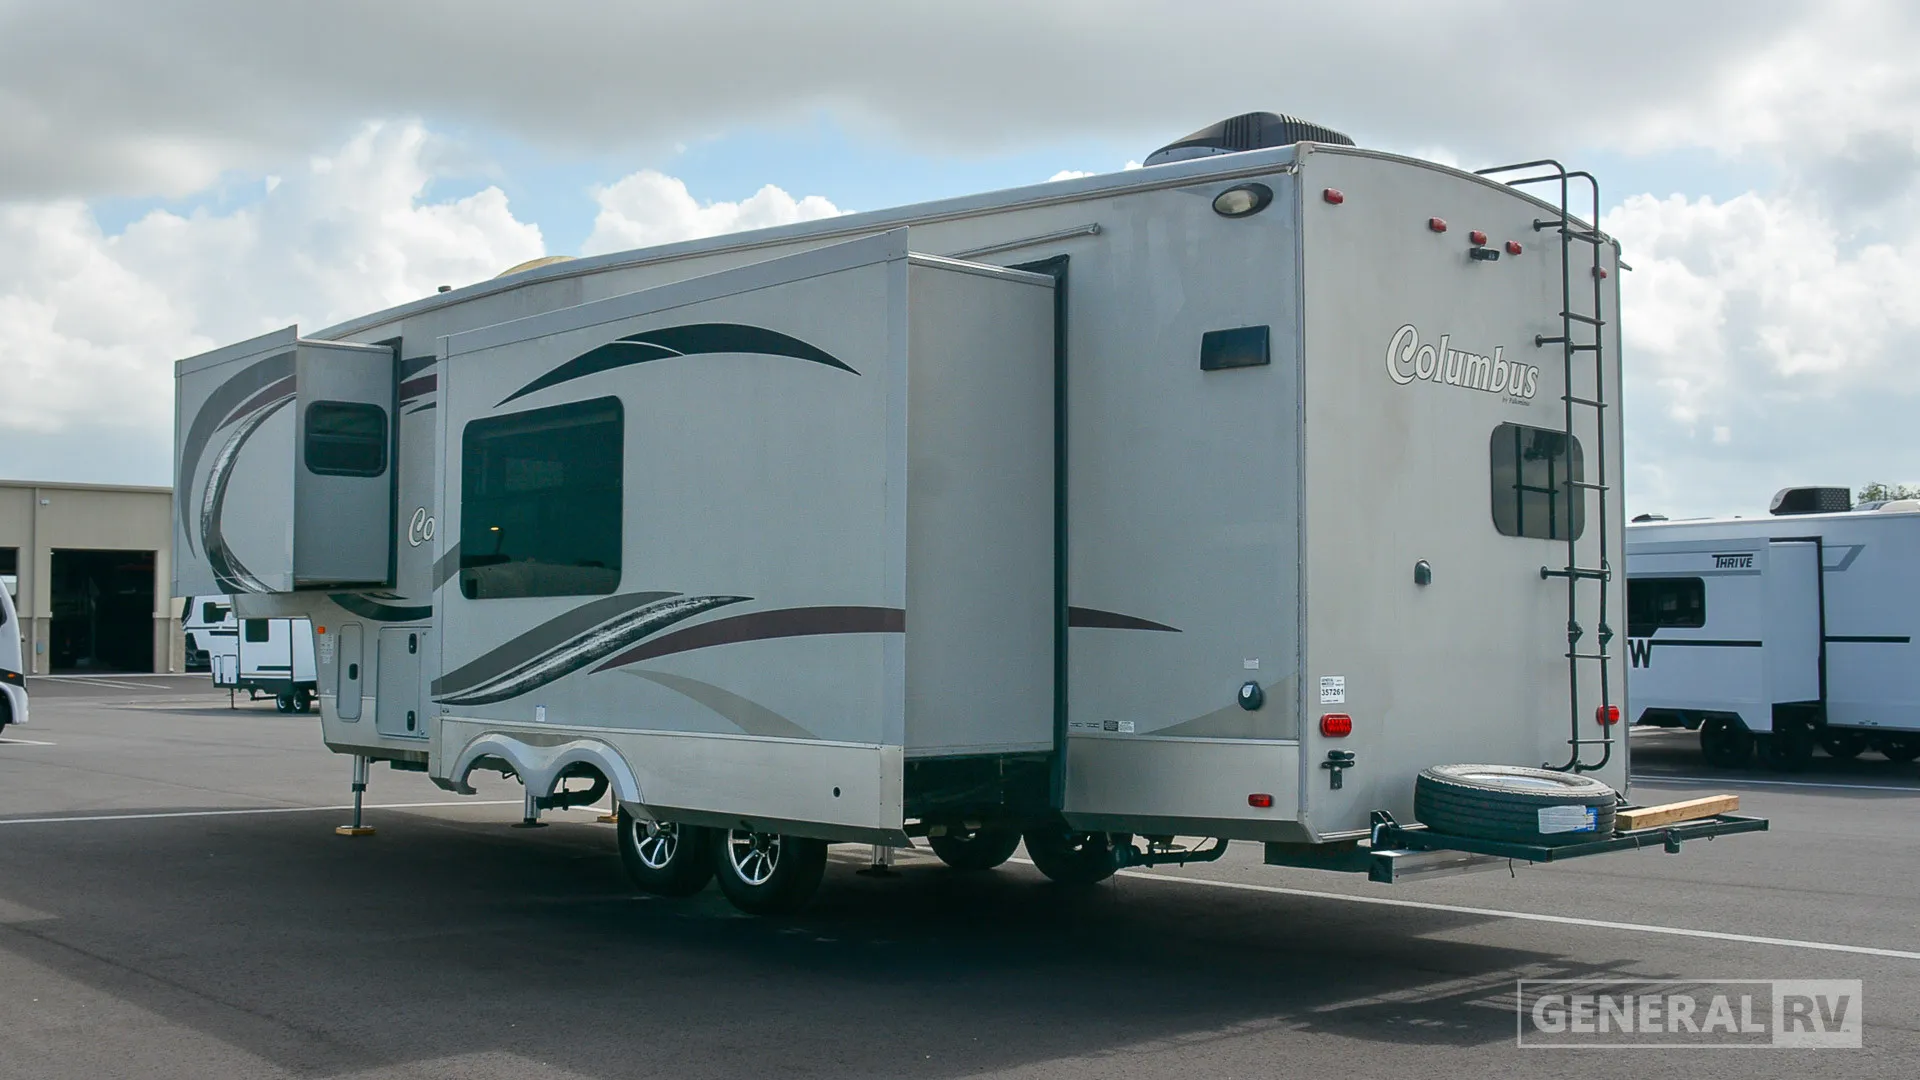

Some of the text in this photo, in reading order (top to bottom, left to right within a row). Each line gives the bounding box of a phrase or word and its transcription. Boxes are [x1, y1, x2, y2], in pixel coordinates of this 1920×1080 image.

[1386, 324, 1539, 399] Columbus
[1712, 553, 1753, 568] THRIVE
[1321, 688, 1344, 696] 357261
